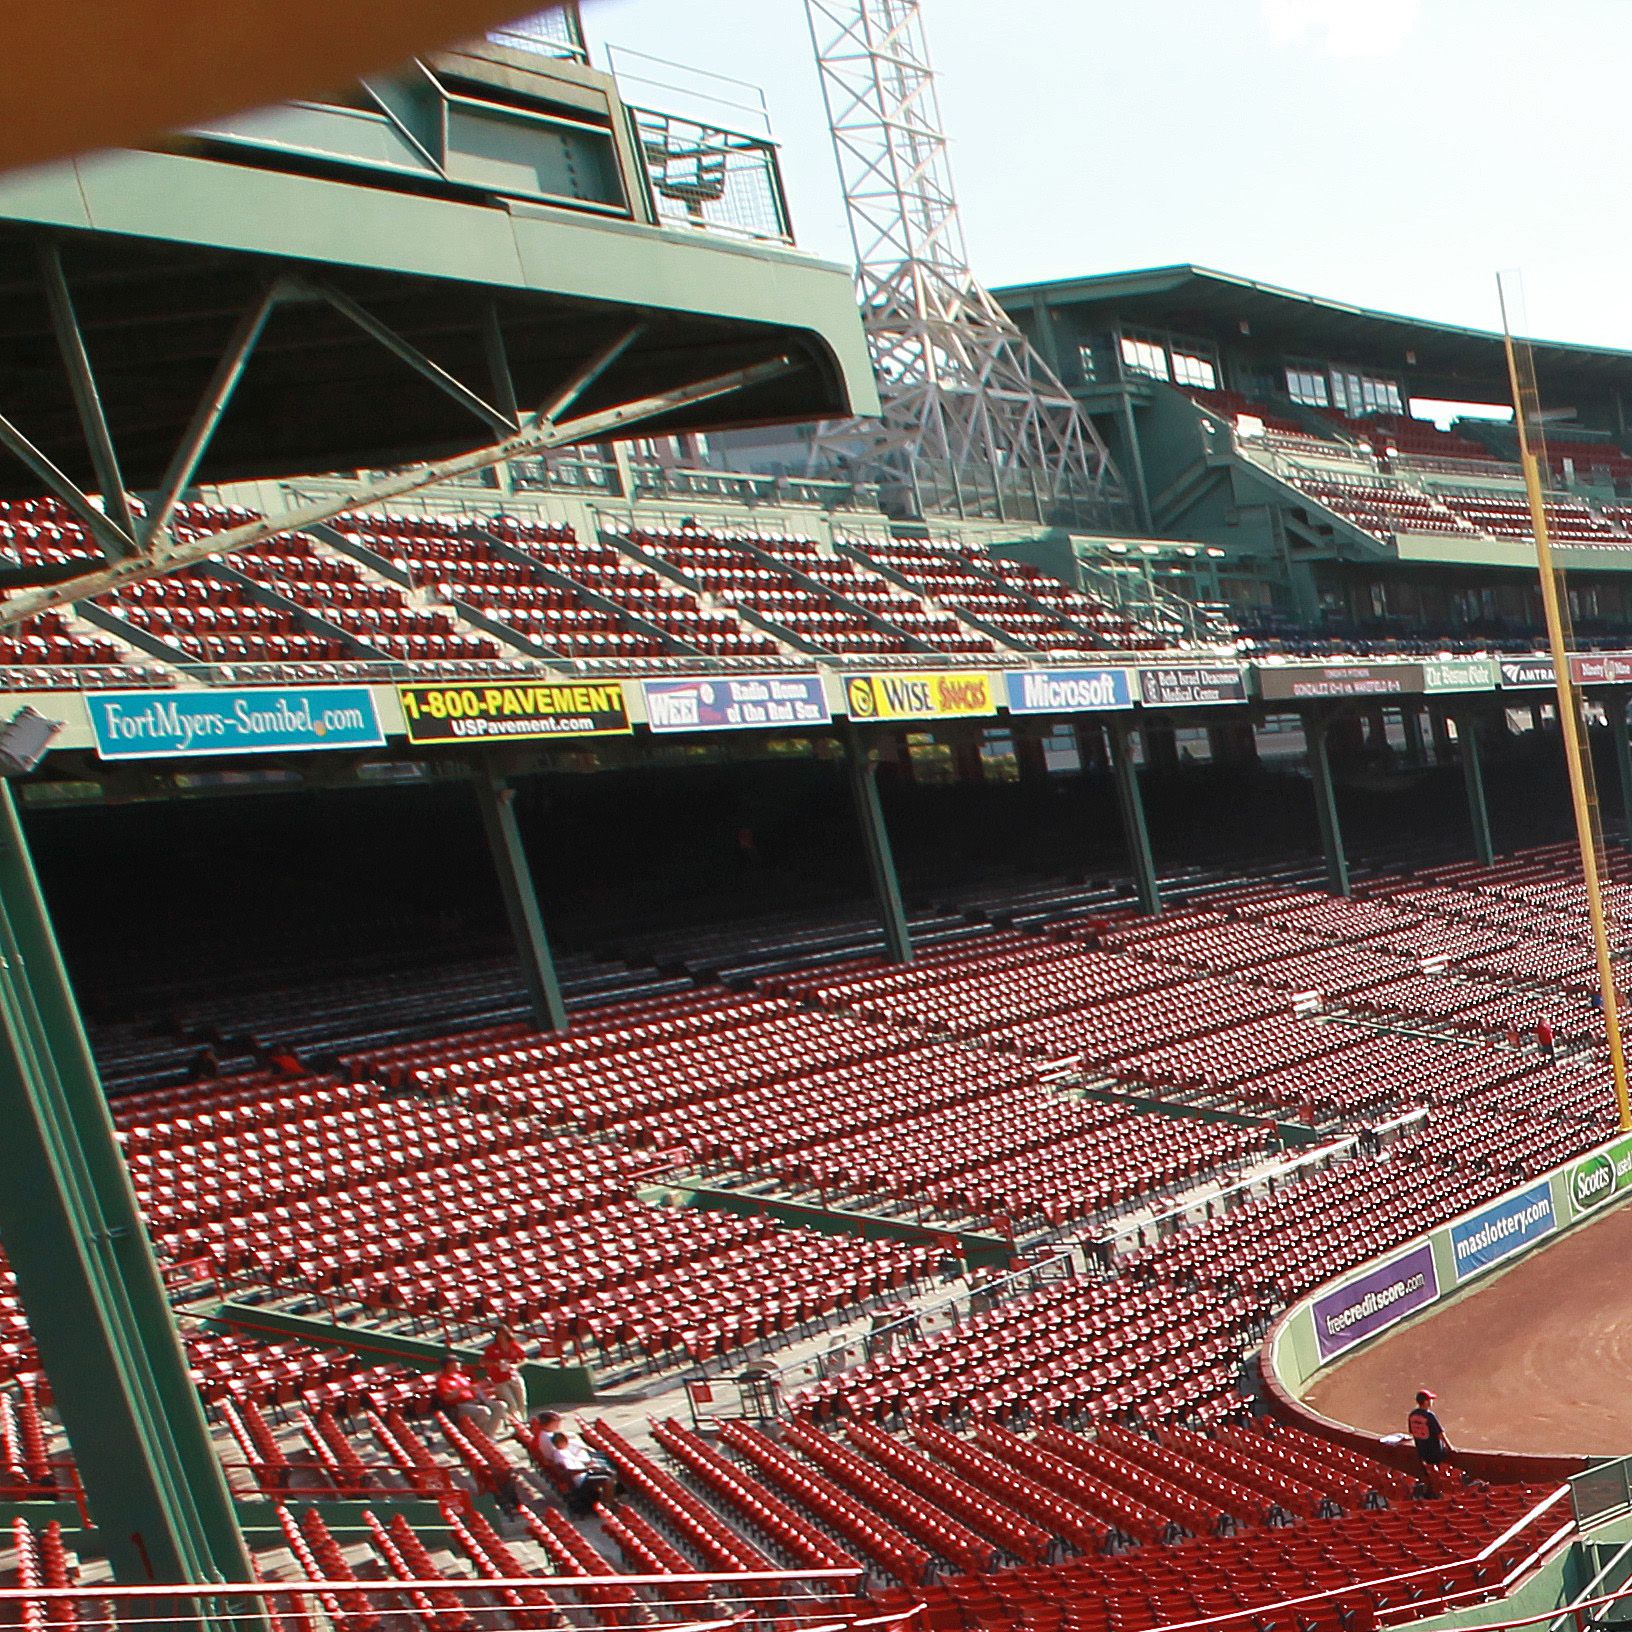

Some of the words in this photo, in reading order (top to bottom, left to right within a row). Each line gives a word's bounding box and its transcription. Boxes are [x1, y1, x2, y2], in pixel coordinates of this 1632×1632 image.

[1158, 670, 1179, 687] Beth
[1179, 670, 1201, 687] Israel
[1201, 669, 1239, 686] Deaconess
[1519, 668, 1557, 682] AMTRA
[1580, 662, 1604, 678] Ninety
[1615, 661, 1631, 675] Nine
[728, 681, 770, 702] Radio
[769, 680, 809, 700] Home
[1022, 672, 1116, 708] Microsoft
[1161, 686, 1192, 702] Medical
[1193, 686, 1220, 702] Center
[401, 685, 624, 721] 1-800-PAVEMENT
[725, 704, 742, 724] of
[743, 702, 767, 722] the
[767, 701, 795, 721] Red
[794, 700, 821, 720] Sox
[103, 697, 365, 750] FortMyers-Sanibel.com
[450, 715, 595, 737] USPavement.com
[1616, 1151, 1632, 1177] used
[1577, 1166, 1610, 1200] Scotts
[1456, 1197, 1551, 1260] masslottery.com
[1325, 1272, 1426, 1336] freecreditscore.com
